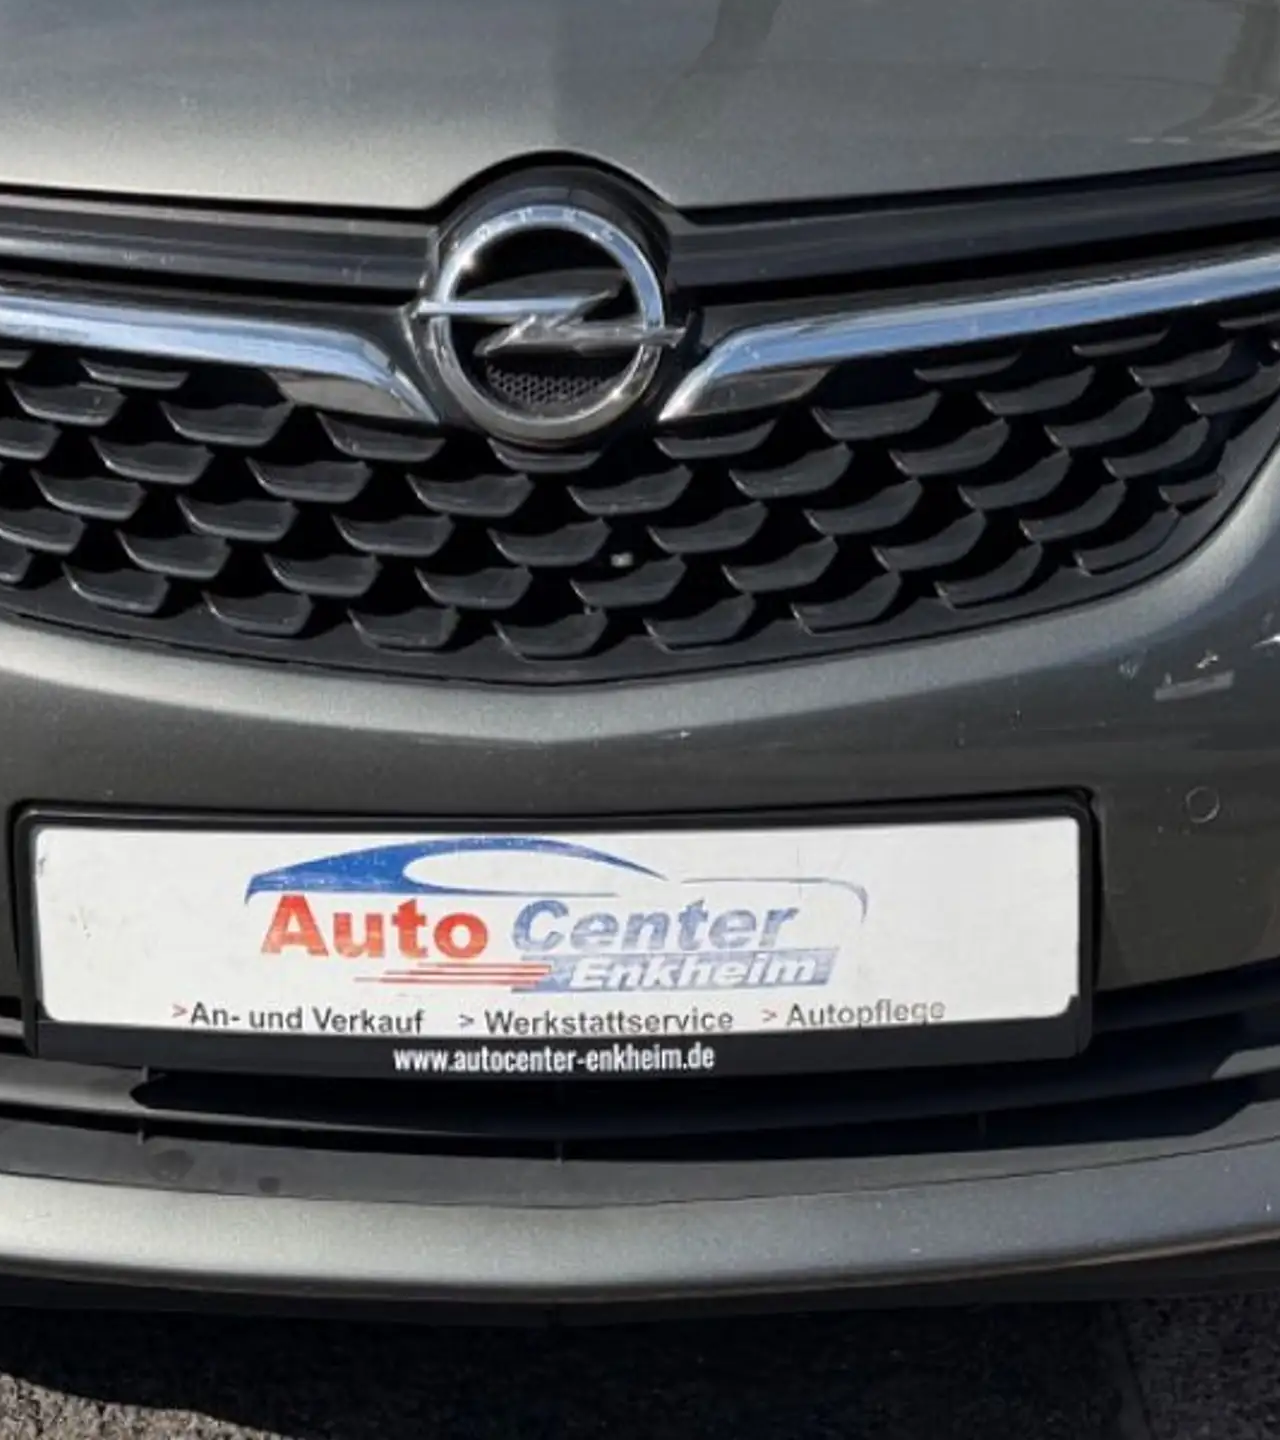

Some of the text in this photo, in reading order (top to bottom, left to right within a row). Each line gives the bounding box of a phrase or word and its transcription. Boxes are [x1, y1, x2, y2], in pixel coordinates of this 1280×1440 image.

[261, 893, 799, 958] Auto Center
[570, 951, 816, 990] Enkheim
[248, 1007, 303, 1032] und
[312, 1008, 424, 1035] Verkauf
[484, 1006, 734, 1036] Werkstattservice
[393, 1042, 716, 1074] www.autocenter-enkheim.de
